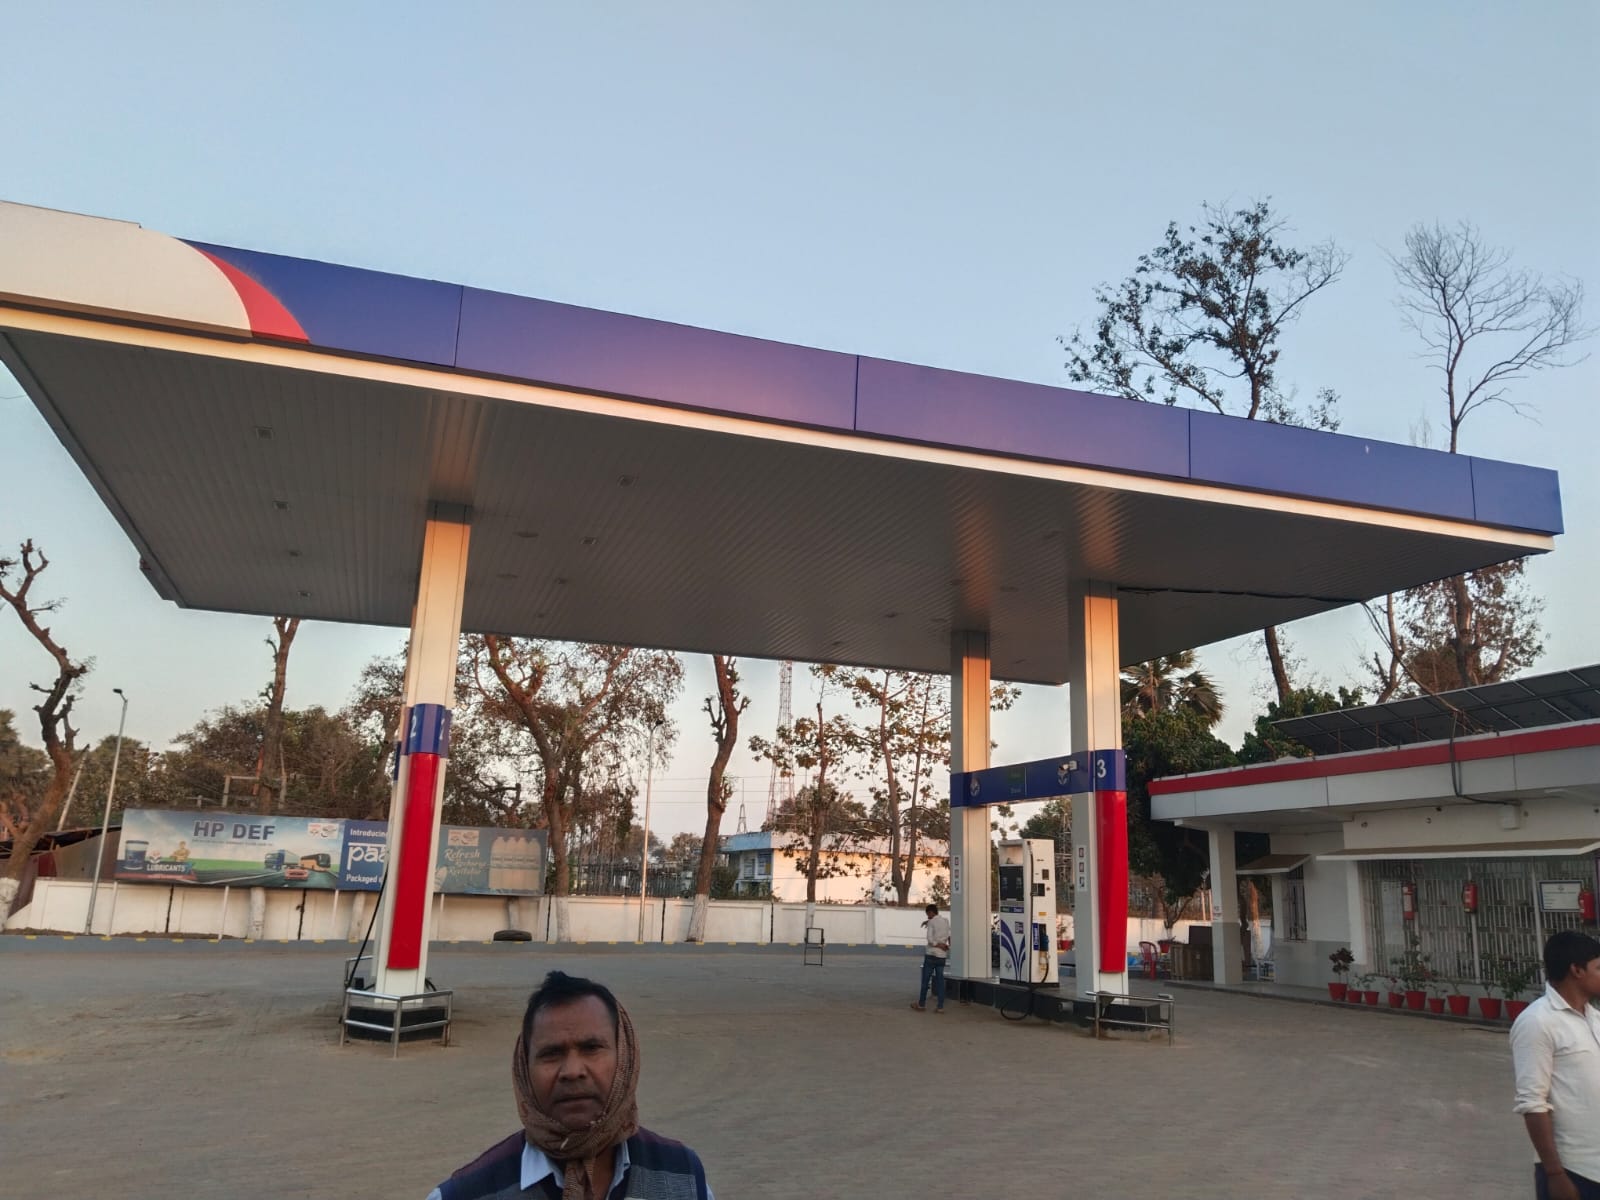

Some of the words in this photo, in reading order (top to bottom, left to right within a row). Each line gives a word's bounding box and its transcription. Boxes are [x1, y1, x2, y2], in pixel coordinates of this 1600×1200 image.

[1096, 759, 1107, 778] 3
[193, 821, 224, 838] HP
[232, 823, 276, 841] DEF
[146, 864, 186, 872] LUBRICANTS
